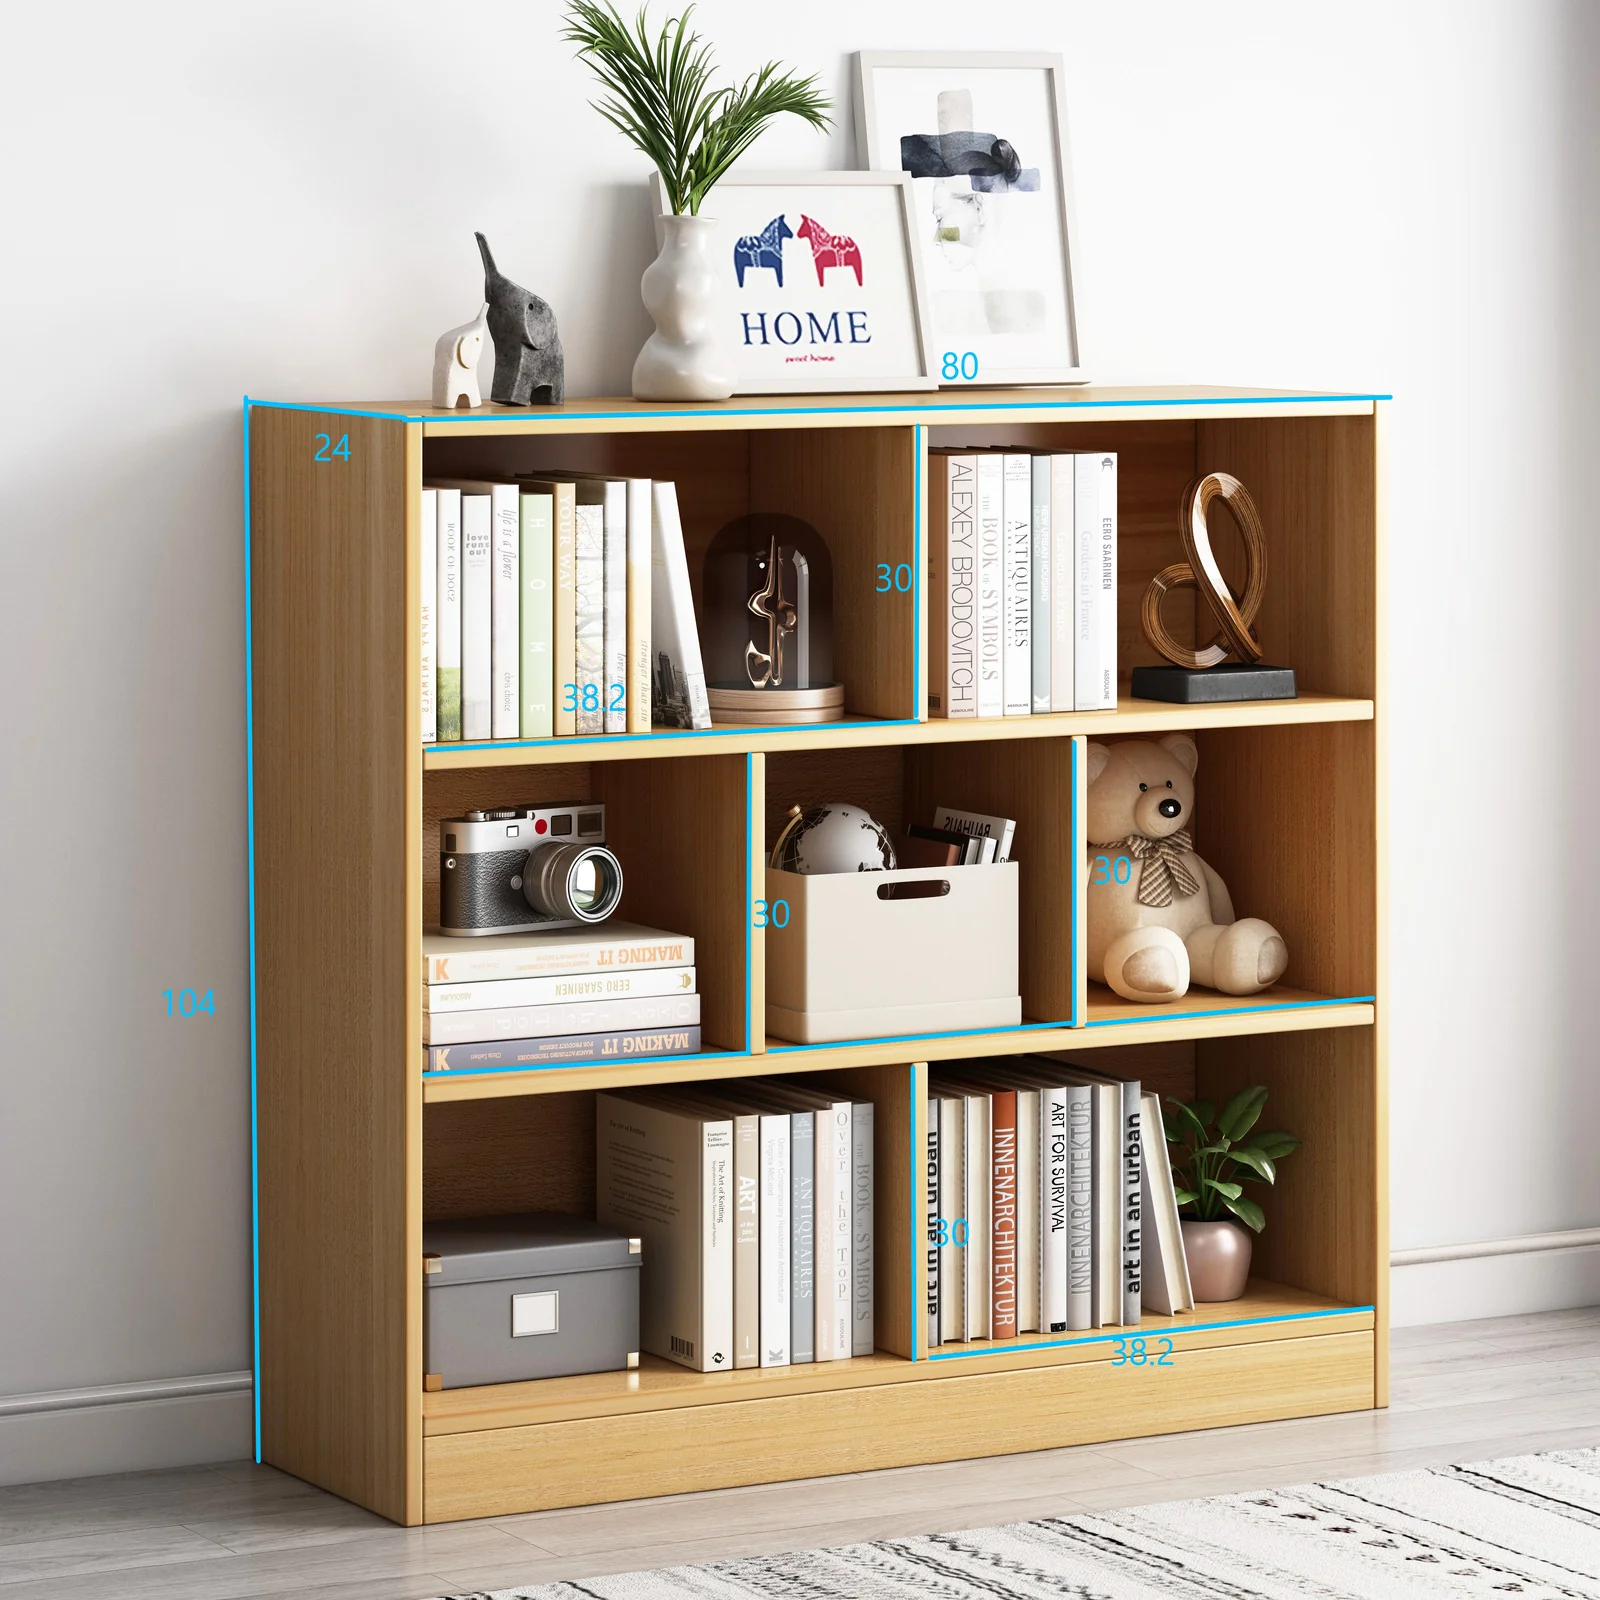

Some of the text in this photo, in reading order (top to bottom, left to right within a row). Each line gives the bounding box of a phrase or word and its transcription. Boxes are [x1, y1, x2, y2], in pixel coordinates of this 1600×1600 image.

[740, 311, 871, 346] HOME
[497, 509, 517, 525] life
[503, 528, 514, 537] is
[466, 533, 489, 541] love
[469, 548, 487, 556] out
[559, 494, 571, 591] YOUR WAY
[982, 517, 999, 569] BOOK
[1102, 517, 1112, 590] EERO SAARINEN
[497, 548, 517, 580] flower
[951, 462, 974, 701] ALEXEY BRODOVITCH
[1012, 521, 1029, 648] ANTIQUAIRES
[982, 589, 999, 681] SYMBOLS
[637, 640, 649, 679] stronger
[640, 682, 651, 705] than
[597, 945, 683, 966] MAKING IT
[555, 979, 631, 997] EERO SAARINEN
[601, 1033, 689, 1055] MAKING IT
[718, 1160, 726, 1172] The
[718, 1174, 726, 1188] Art
[1051, 1102, 1065, 1233] ART FOR SURVIVAL
[739, 1175, 756, 1214] ART
[856, 1163, 872, 1213] BOOK
[1070, 1100, 1092, 1296] INNENARCHITEKTUR
[1123, 1112, 1141, 1294] art in an urban
[717, 1196, 726, 1224] Knitting
[994, 1127, 1015, 1326] INNENARCHITEKTUR
[799, 1176, 812, 1298] ANTIQUAIRES
[856, 1232, 872, 1321] SYMBOLS
